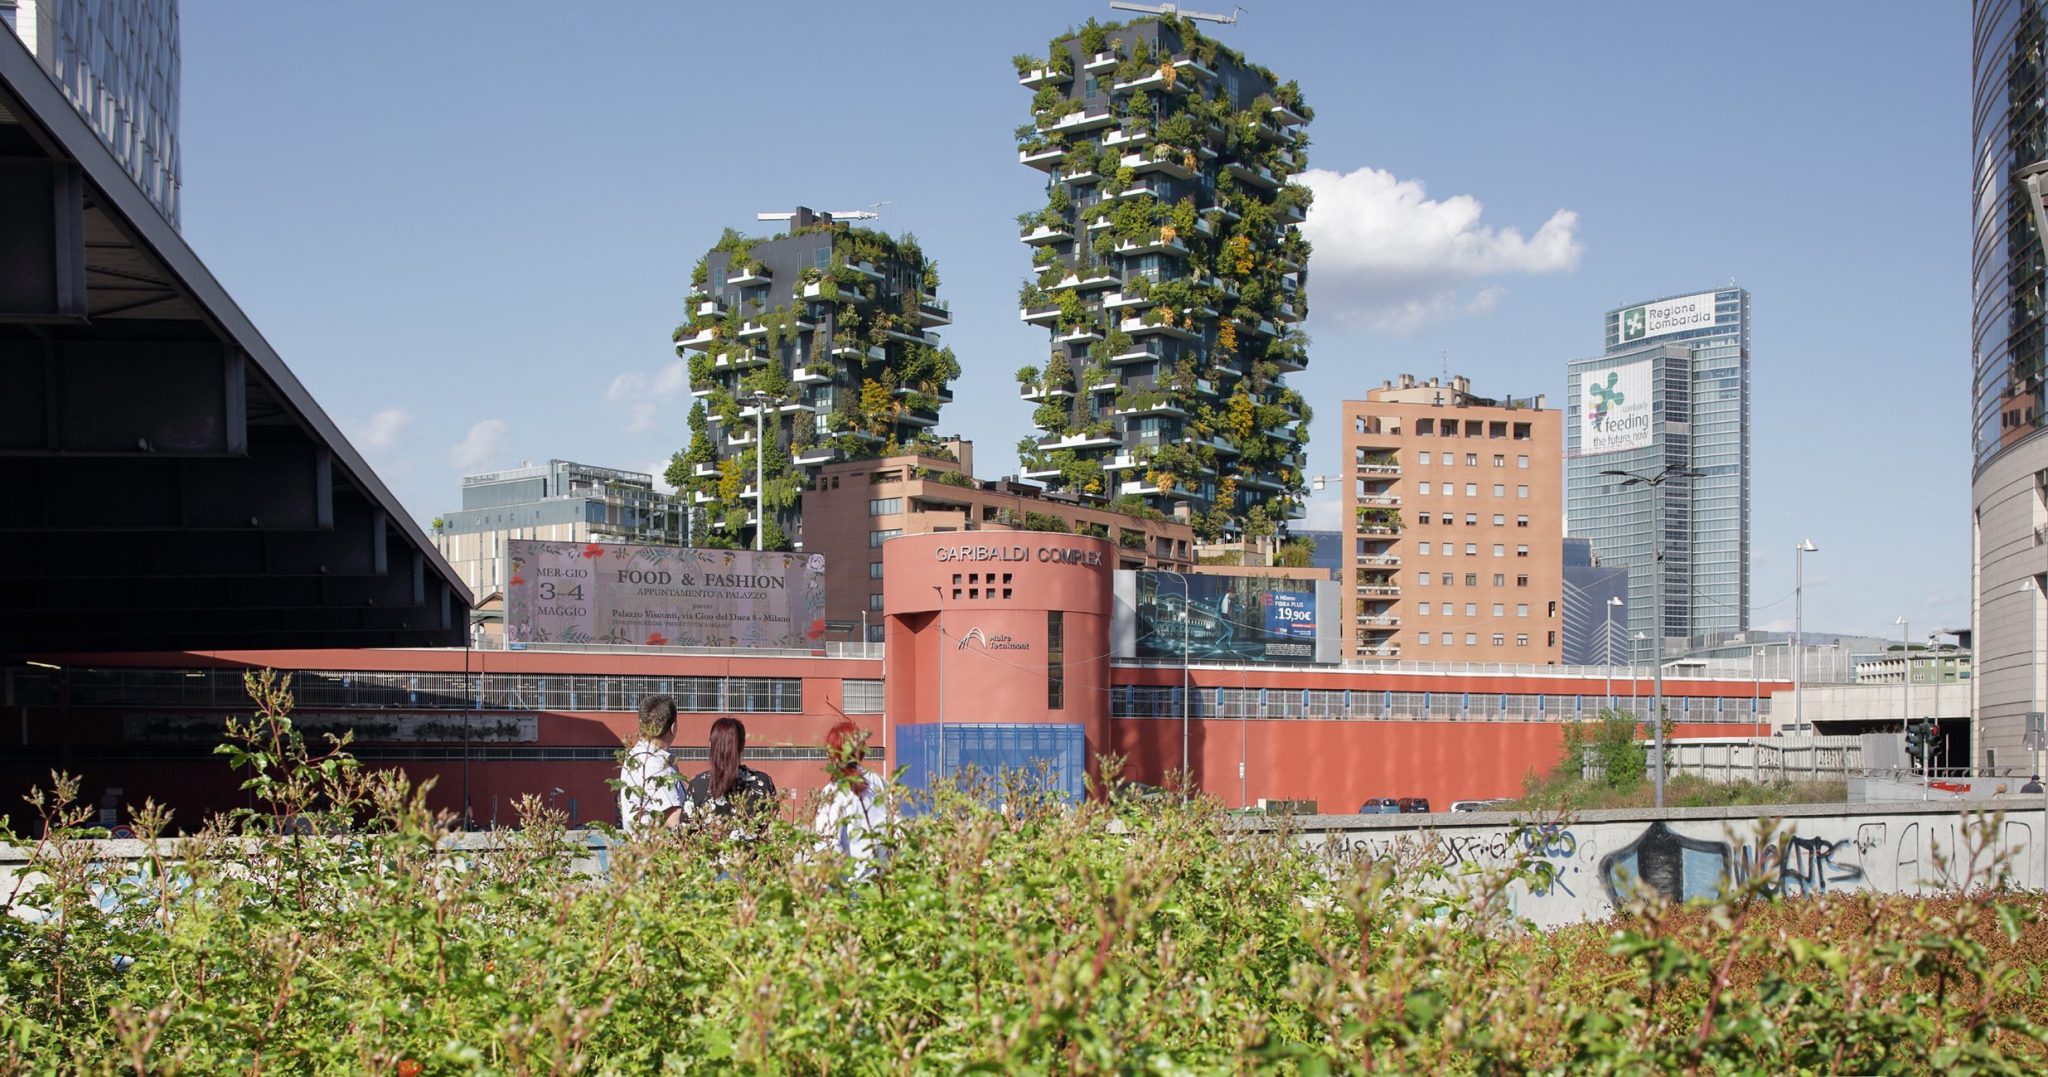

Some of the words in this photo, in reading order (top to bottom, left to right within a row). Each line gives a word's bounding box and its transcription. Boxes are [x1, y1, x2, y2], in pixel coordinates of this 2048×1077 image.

[1649, 304, 1696, 319] Regione
[1649, 312, 1711, 331] Lombardia
[1605, 413, 1649, 432] feeding
[1593, 436, 1606, 447] the
[935, 545, 1030, 562] GARIBALDI
[1037, 547, 1102, 566] COMPLEX
[536, 567, 588, 579] MER-GIO
[617, 569, 672, 585] FOOD
[681, 573, 695, 586] &
[704, 573, 785, 590] FASHION
[637, 587, 715, 598] APPUNTAMENTO
[717, 591, 724, 599] A
[725, 591, 767, 600] PALAZZO
[537, 606, 587, 617] MAGGIO
[612, 609, 643, 618] Palazzo
[644, 610, 680, 621] Visconti,
[681, 612, 693, 620] via
[695, 612, 714, 621] Cino
[716, 613, 728, 621] del
[730, 613, 750, 622] Duca
[763, 614, 791, 623] Milano
[989, 642, 1030, 650] Tecnimont
